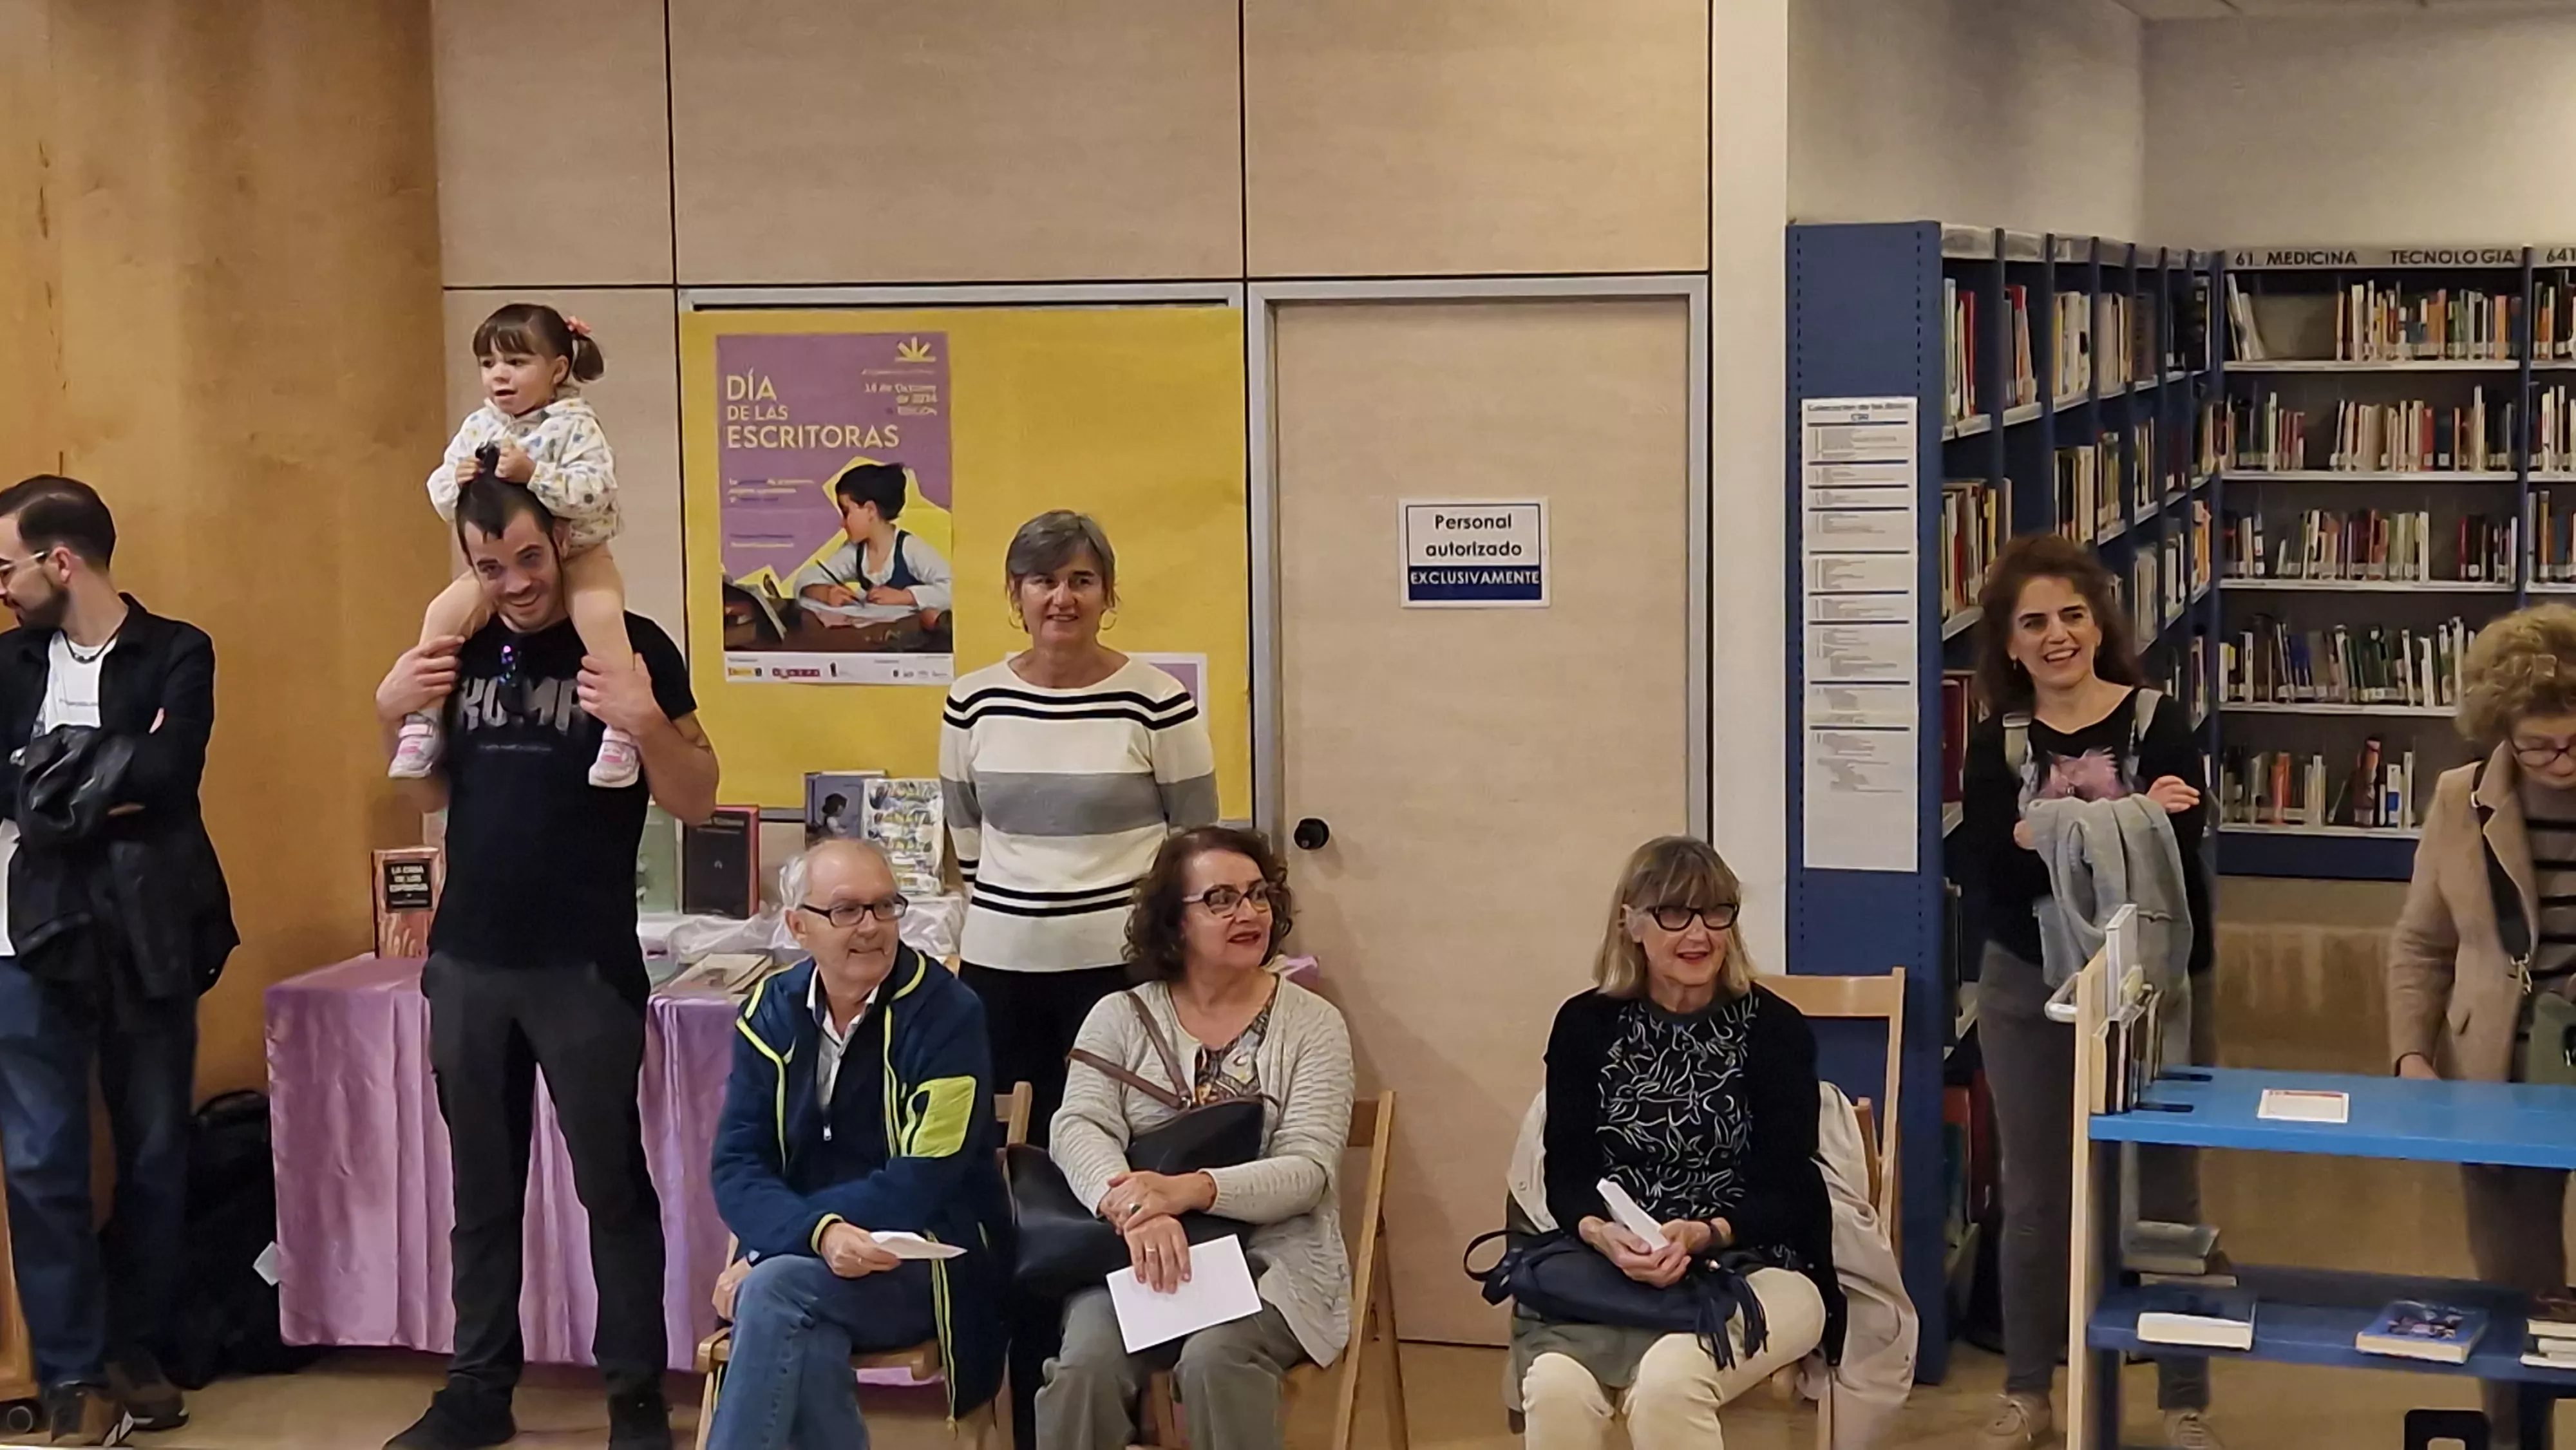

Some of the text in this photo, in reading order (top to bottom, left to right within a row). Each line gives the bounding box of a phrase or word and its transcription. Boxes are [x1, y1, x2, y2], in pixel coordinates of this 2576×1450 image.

[2235, 249, 2515, 266] 61 MEDICINA TECNOLOGIA
[726, 367, 777, 401] DÍA
[726, 404, 789, 420] DE LAS
[726, 424, 900, 449] ESCRITORAS
[1435, 513, 1511, 530] Personal
[1425, 540, 1523, 557] autorizado
[1410, 570, 1540, 585] EXCLUSIVAMENTE
